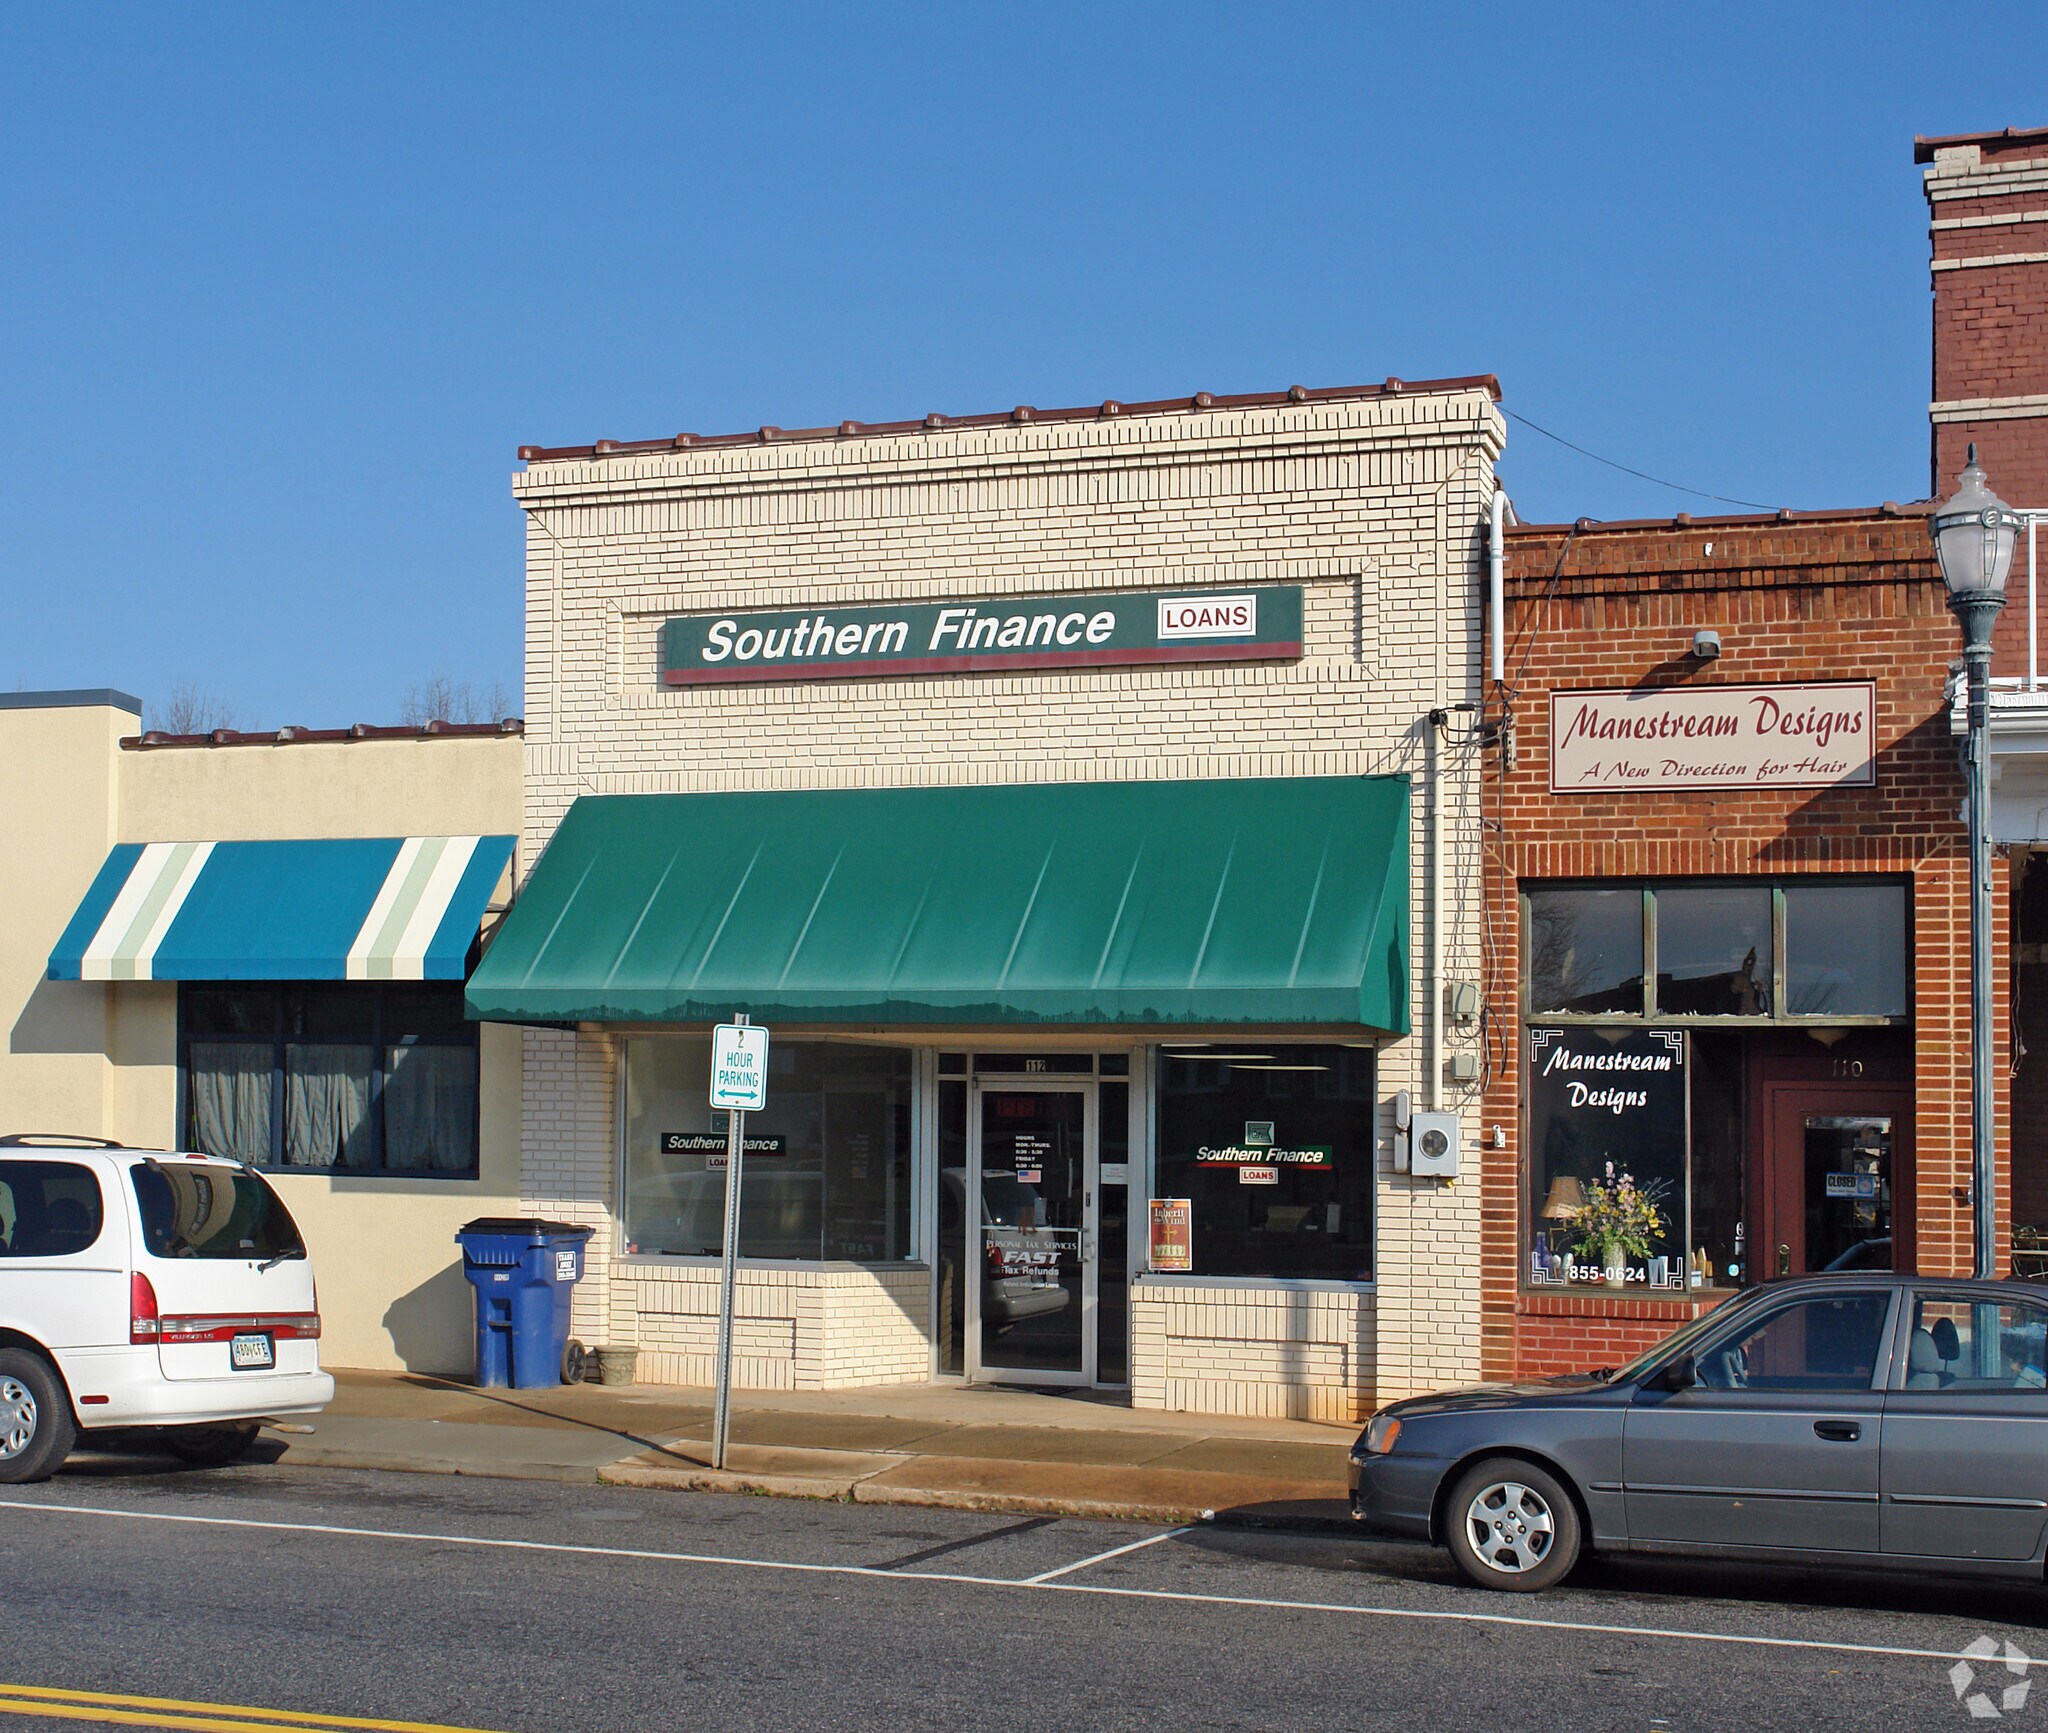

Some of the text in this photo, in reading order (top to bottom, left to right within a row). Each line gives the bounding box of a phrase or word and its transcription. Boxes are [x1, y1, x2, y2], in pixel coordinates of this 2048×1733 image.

[1165, 606, 1249, 628] LOANS
[702, 607, 1115, 662] Southern Finance
[1561, 695, 1863, 750] Manestream Designs
[1578, 757, 1847, 783] A New Direction for Hair
[738, 1034, 744, 1048] 2
[726, 1052, 754, 1068] HOUR
[1028, 1061, 1044, 1072] 112
[1543, 1045, 1671, 1077] Manestream
[1832, 1059, 1863, 1078] 110
[718, 1070, 759, 1088] PARKING
[1566, 1082, 1647, 1115] Designs
[668, 1136, 779, 1151] Southern nance
[1196, 1147, 1324, 1163] Southern Finance
[709, 1159, 728, 1167] LOA
[1243, 1172, 1274, 1180] LOANS
[1828, 1176, 1856, 1188] CLOSED
[1154, 1208, 1184, 1217] Inherit
[1162, 1216, 1186, 1225] Wind
[986, 1240, 1077, 1251] PERSONAL TAX SERVICES
[1003, 1251, 1062, 1265] FAST
[1004, 1266, 1059, 1276] Tax Refunds
[1569, 1265, 1646, 1282] 855-0624
